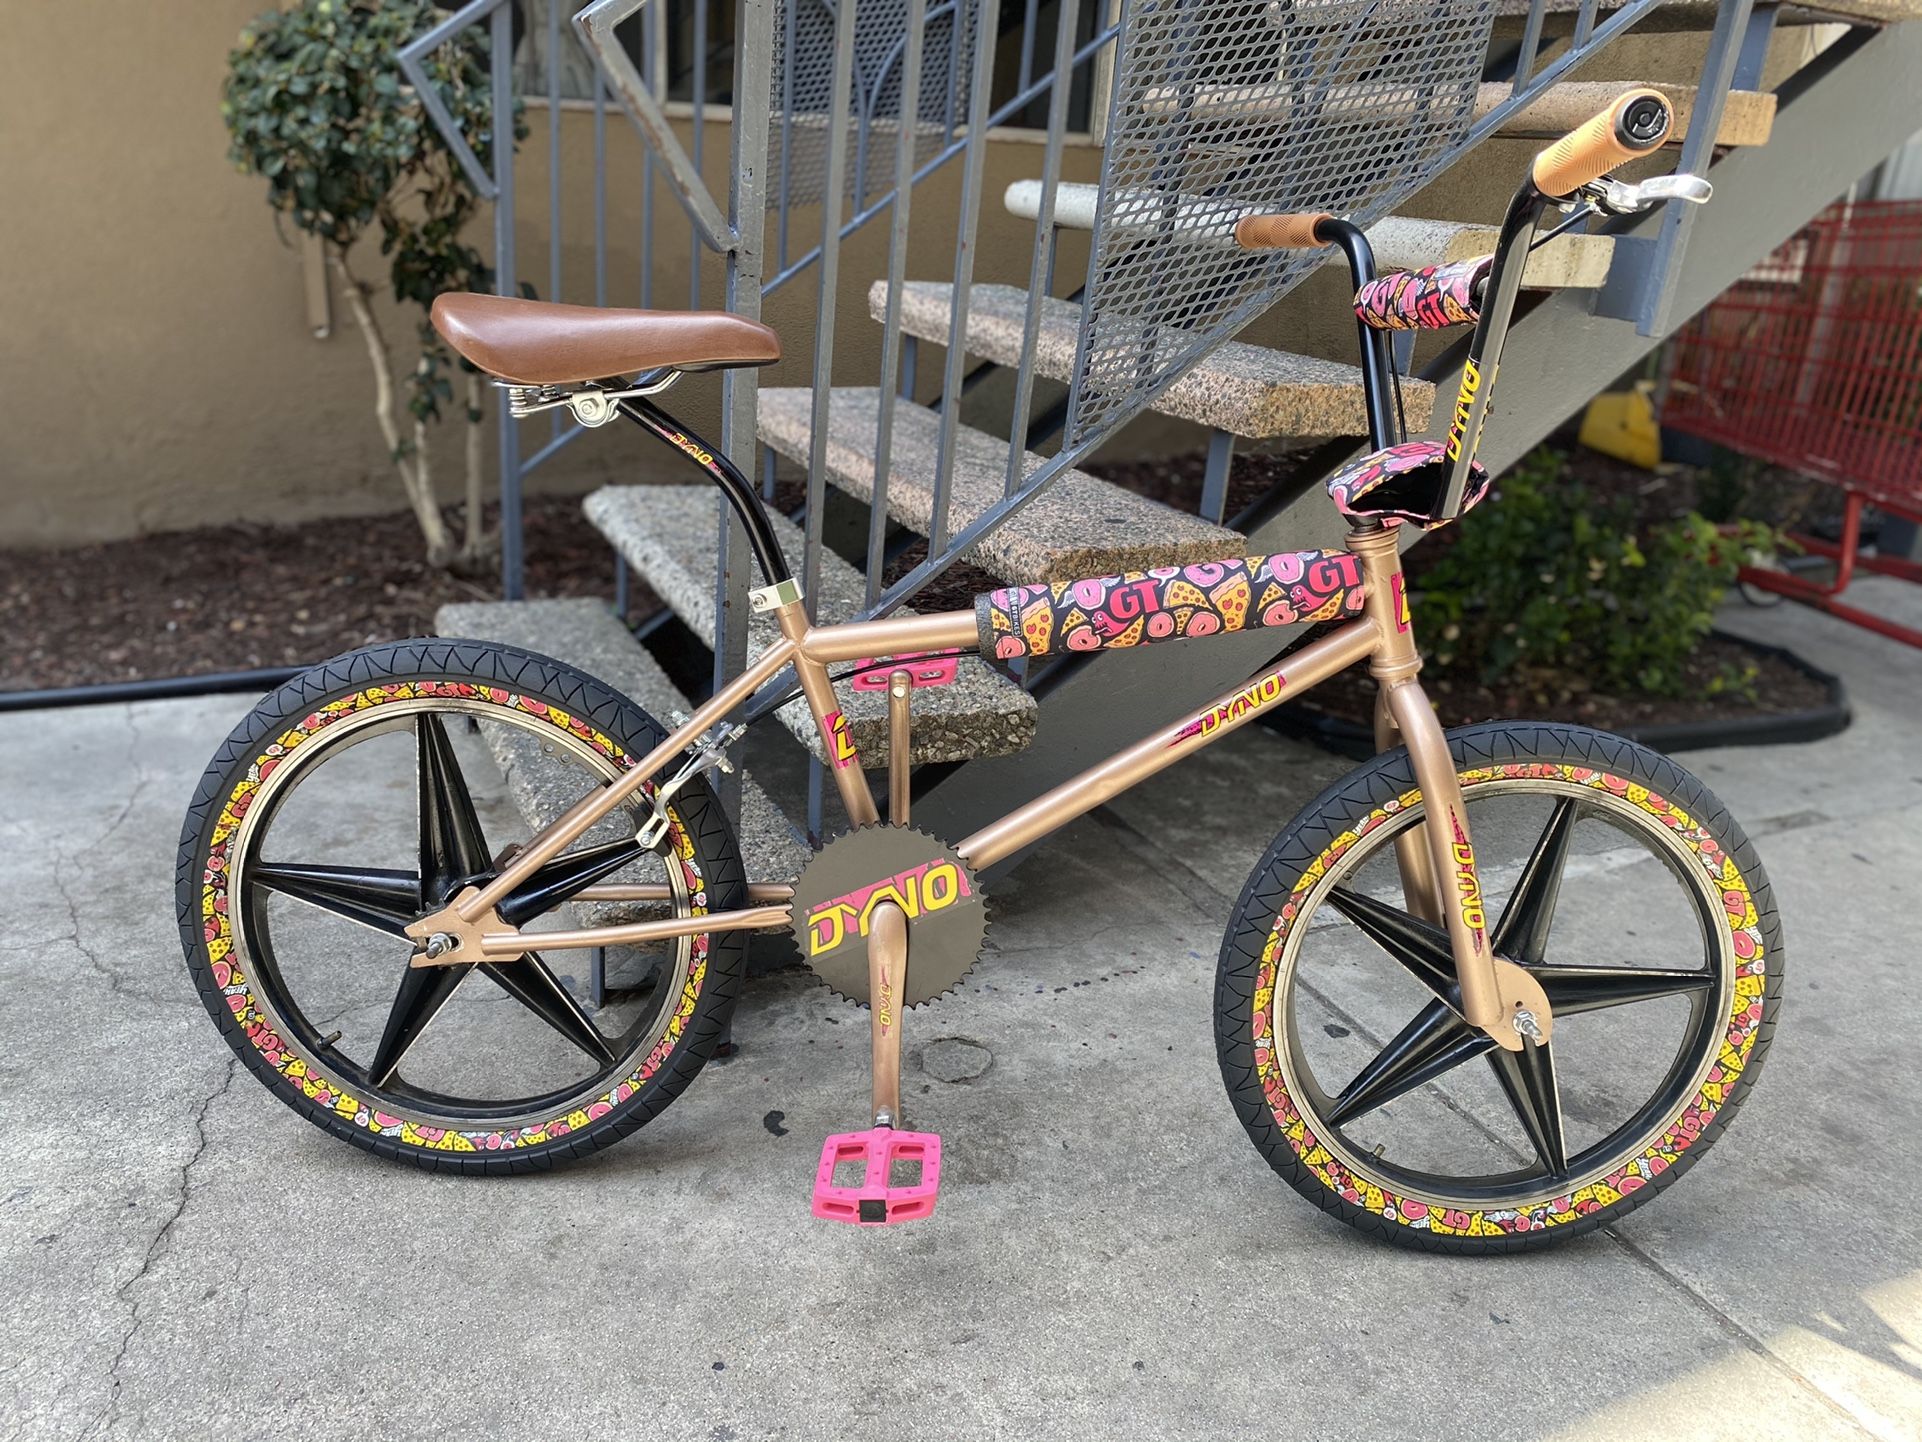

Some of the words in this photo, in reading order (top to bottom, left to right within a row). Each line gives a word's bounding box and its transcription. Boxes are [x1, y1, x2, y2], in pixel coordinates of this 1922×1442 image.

[1417, 292, 1450, 329] GT
[670, 432, 713, 465] DYNO
[1309, 557, 1361, 594] GT
[1109, 579, 1160, 620] GT
[1199, 672, 1282, 738] DYNO
[1452, 842, 1486, 929] DYNO
[807, 863, 959, 957] DYNO
[1723, 890, 1746, 917] GT
[879, 983, 893, 1026] DYNO
[252, 1030, 278, 1050] GT
[647, 1046, 661, 1072] GT
[1266, 1087, 1287, 1109] GT
[1680, 1116, 1701, 1142] GT
[1442, 1208, 1471, 1230] GT
